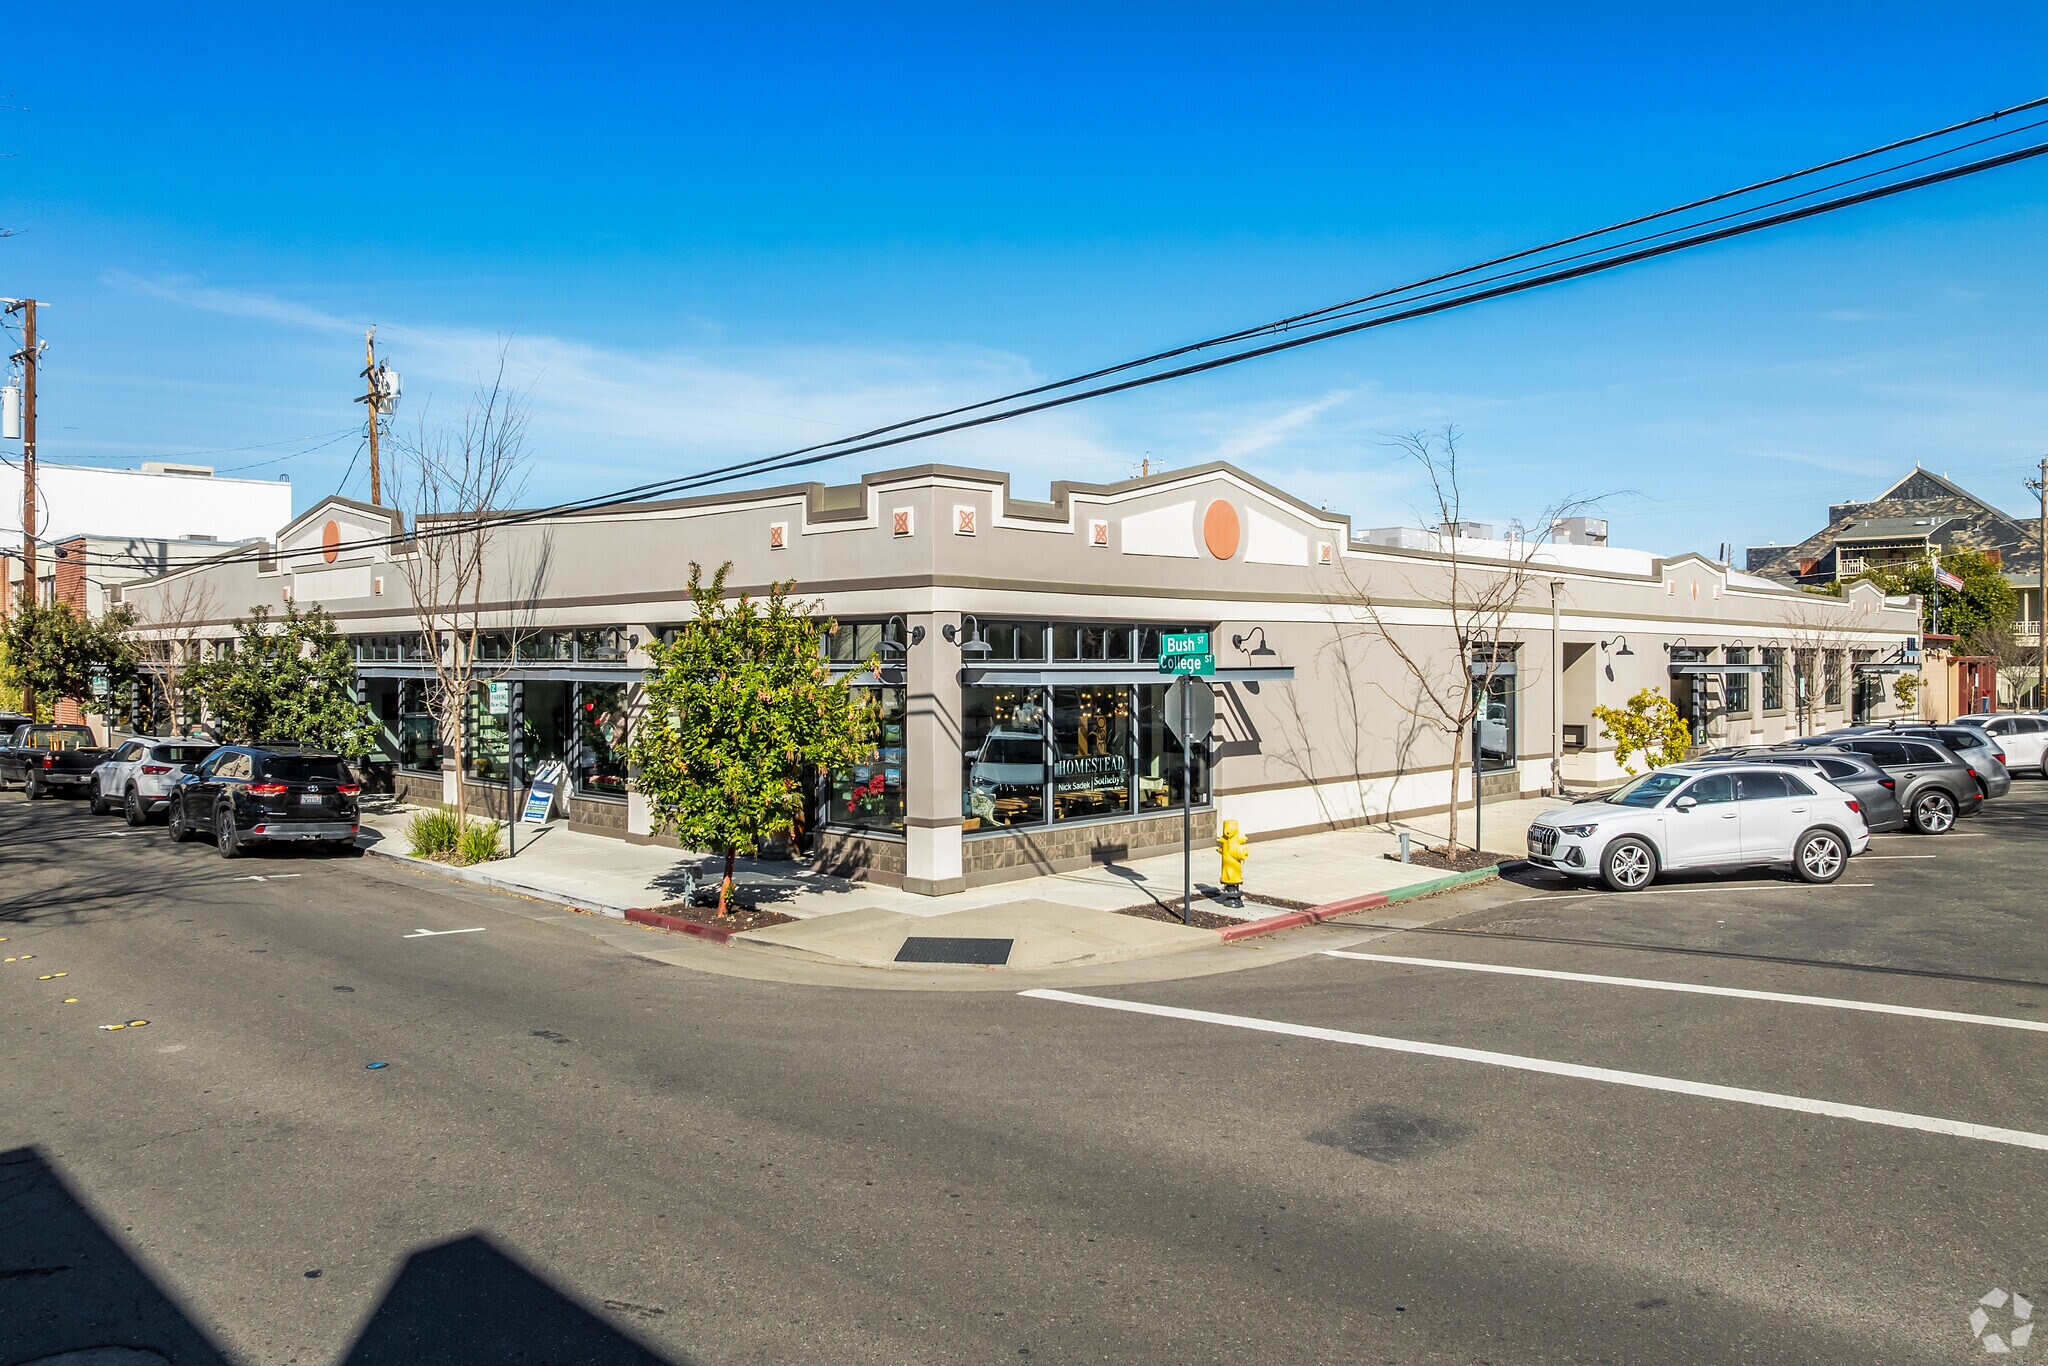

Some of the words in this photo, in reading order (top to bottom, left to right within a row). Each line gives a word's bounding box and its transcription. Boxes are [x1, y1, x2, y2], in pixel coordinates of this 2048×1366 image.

[1167, 637, 1195, 652] Bush
[1197, 636, 1204, 644] ST
[1160, 655, 1201, 674] College
[1204, 655, 1213, 663] ST
[1059, 755, 1125, 775] HOMESTEAD
[1058, 783, 1072, 791] Nick
[1072, 781, 1091, 790] Sadek
[1094, 775, 1125, 786] Sotheby's
